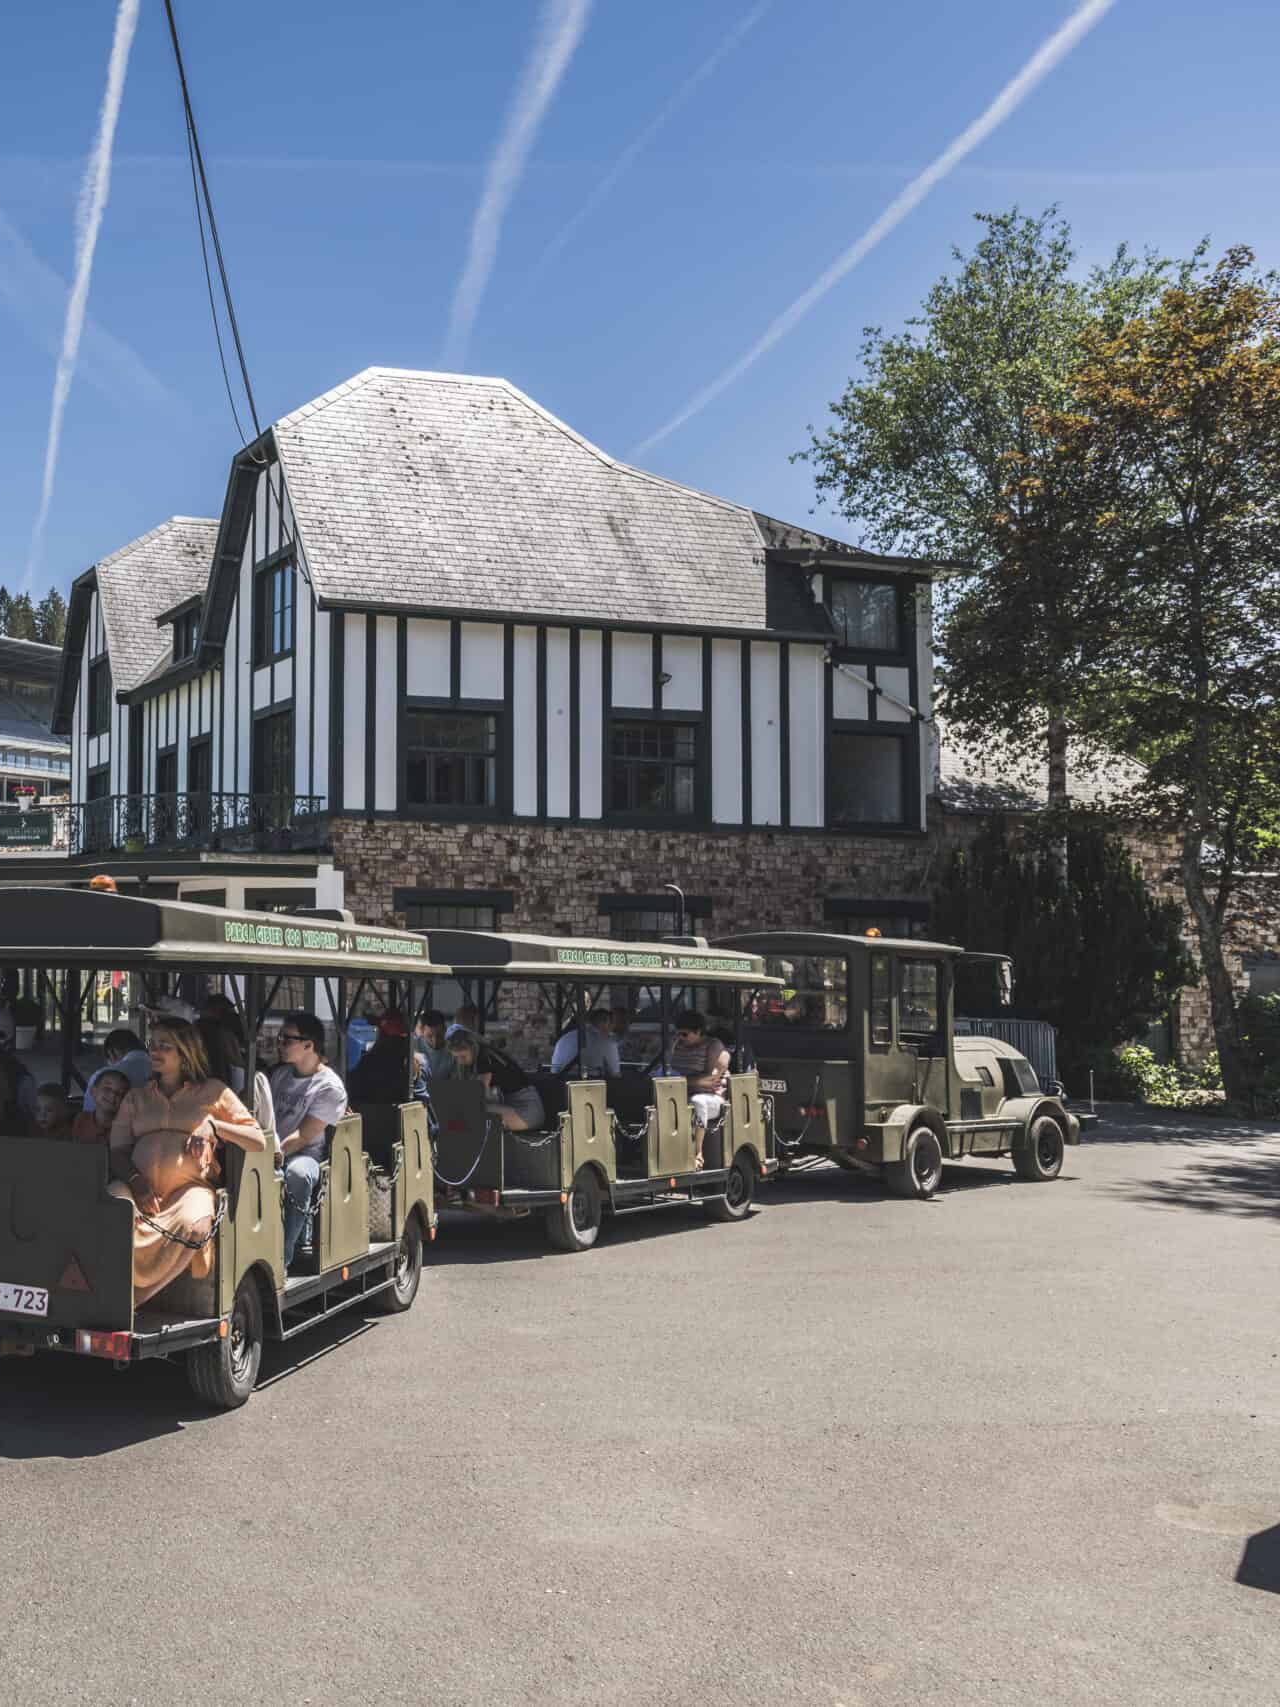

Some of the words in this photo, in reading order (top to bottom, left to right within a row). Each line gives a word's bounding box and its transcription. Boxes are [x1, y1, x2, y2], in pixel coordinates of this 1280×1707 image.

[224, 921, 248, 943] PARC
[248, 924, 256, 944] A
[256, 925, 283, 946] GIBIER
[284, 928, 301, 946] COO
[558, 949, 577, 963] PARC
[610, 952, 626, 966] COO
